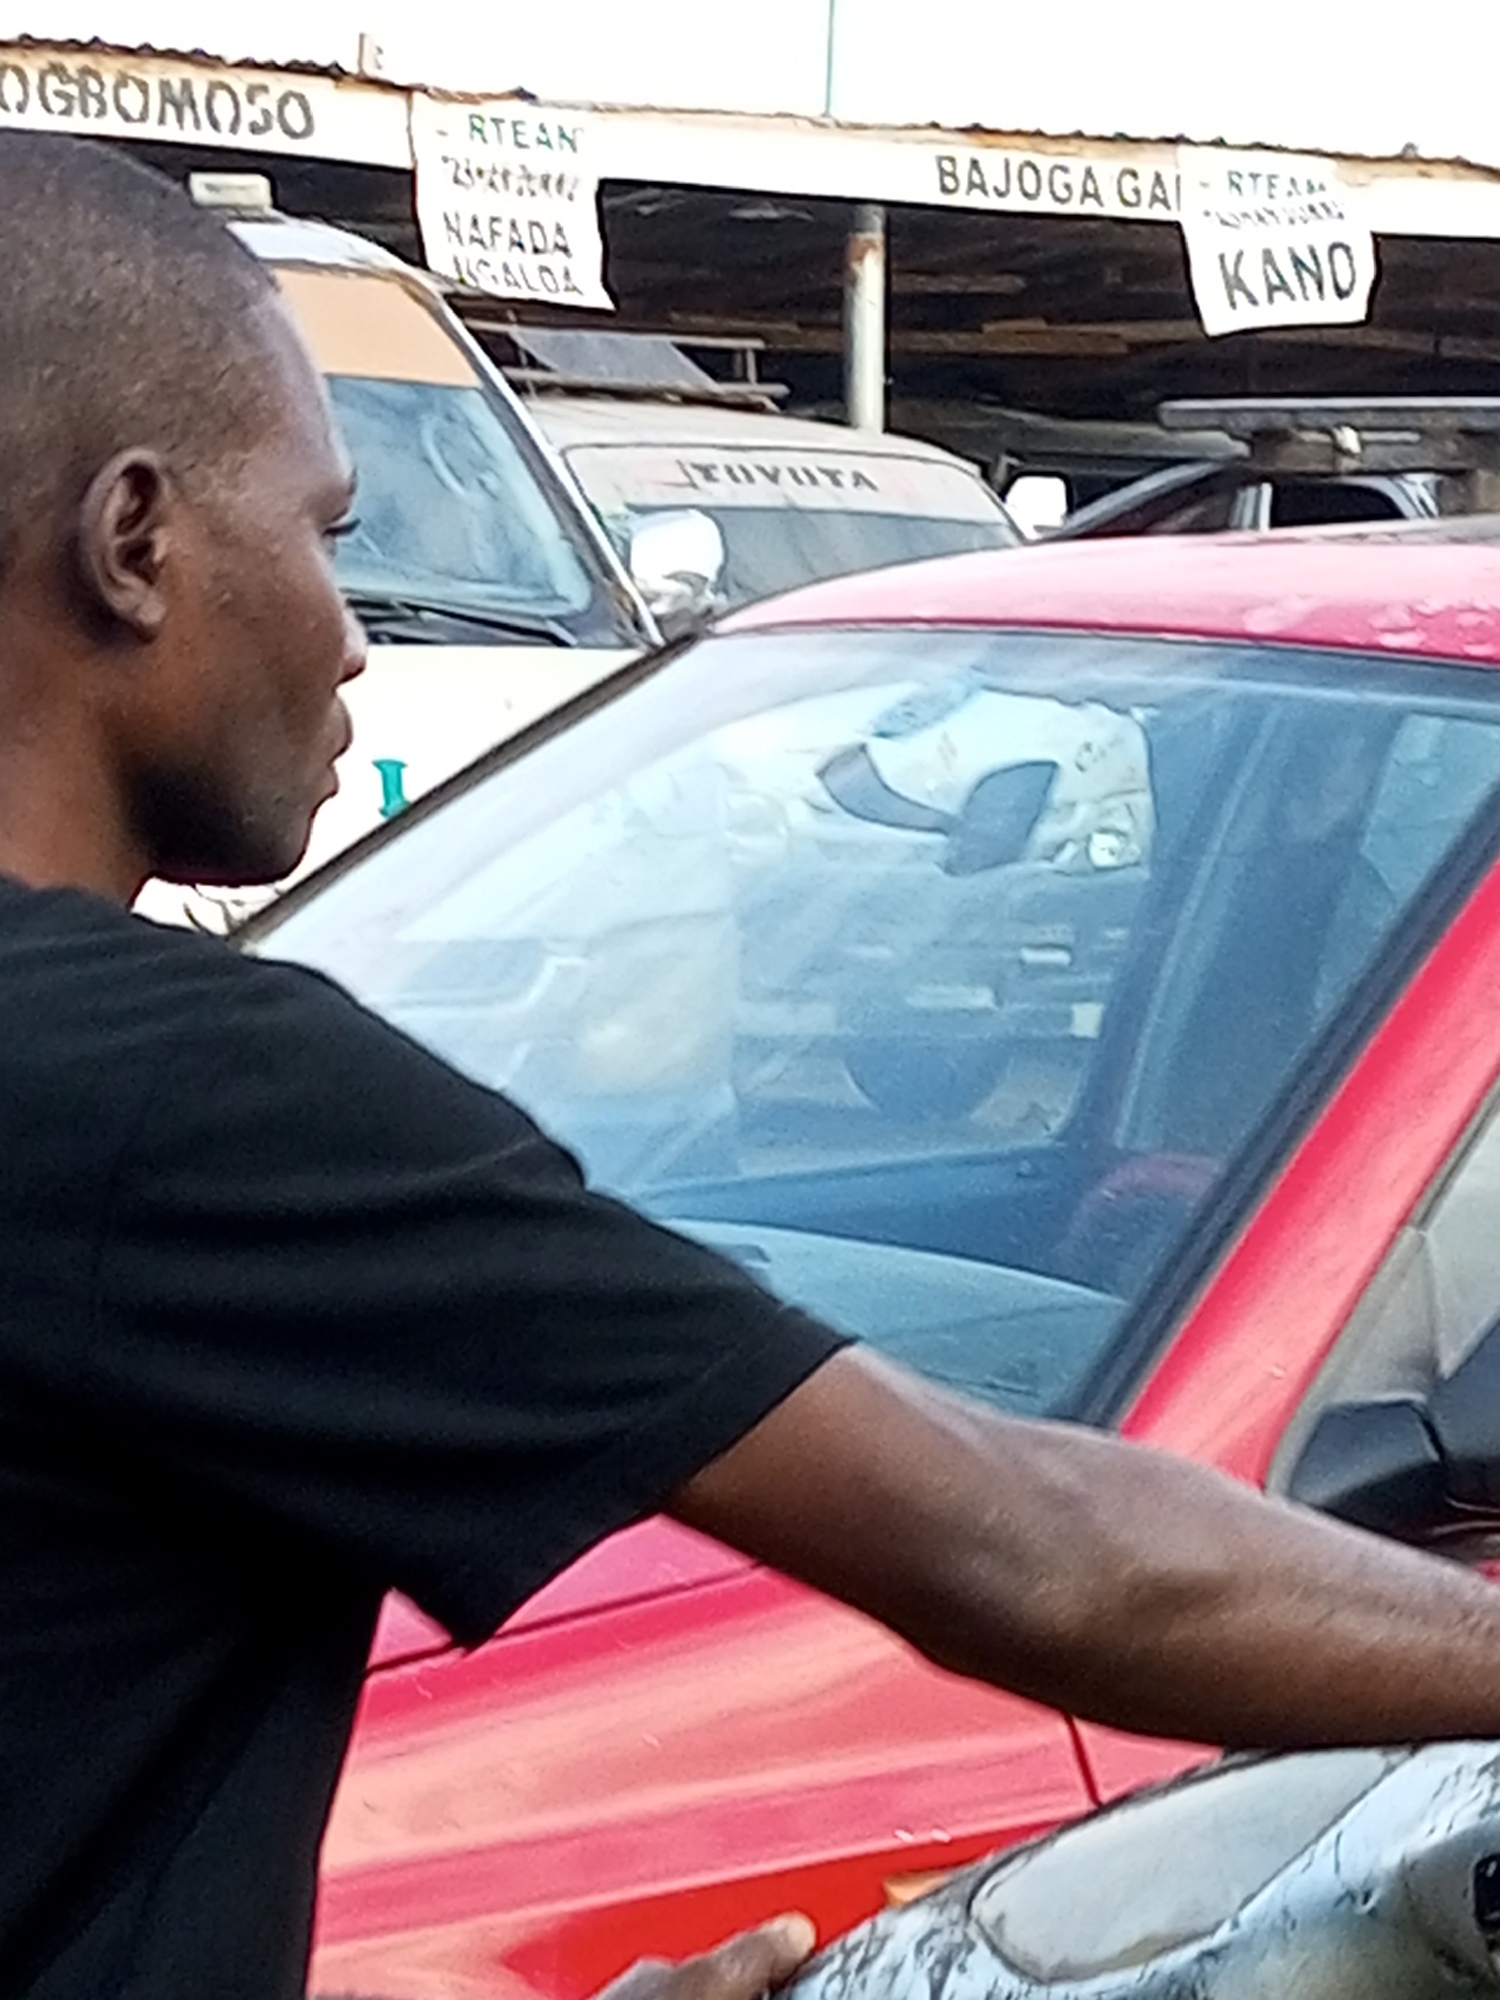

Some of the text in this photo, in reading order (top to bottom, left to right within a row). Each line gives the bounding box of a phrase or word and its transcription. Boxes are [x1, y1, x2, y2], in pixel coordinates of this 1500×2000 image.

[0, 61, 315, 140] OGBOMOSO
[934, 154, 1105, 208] BAJOGA
[443, 210, 573, 258] NAFADA
[1218, 241, 1356, 310] KANO
[689, 462, 879, 492] TOYOTA
